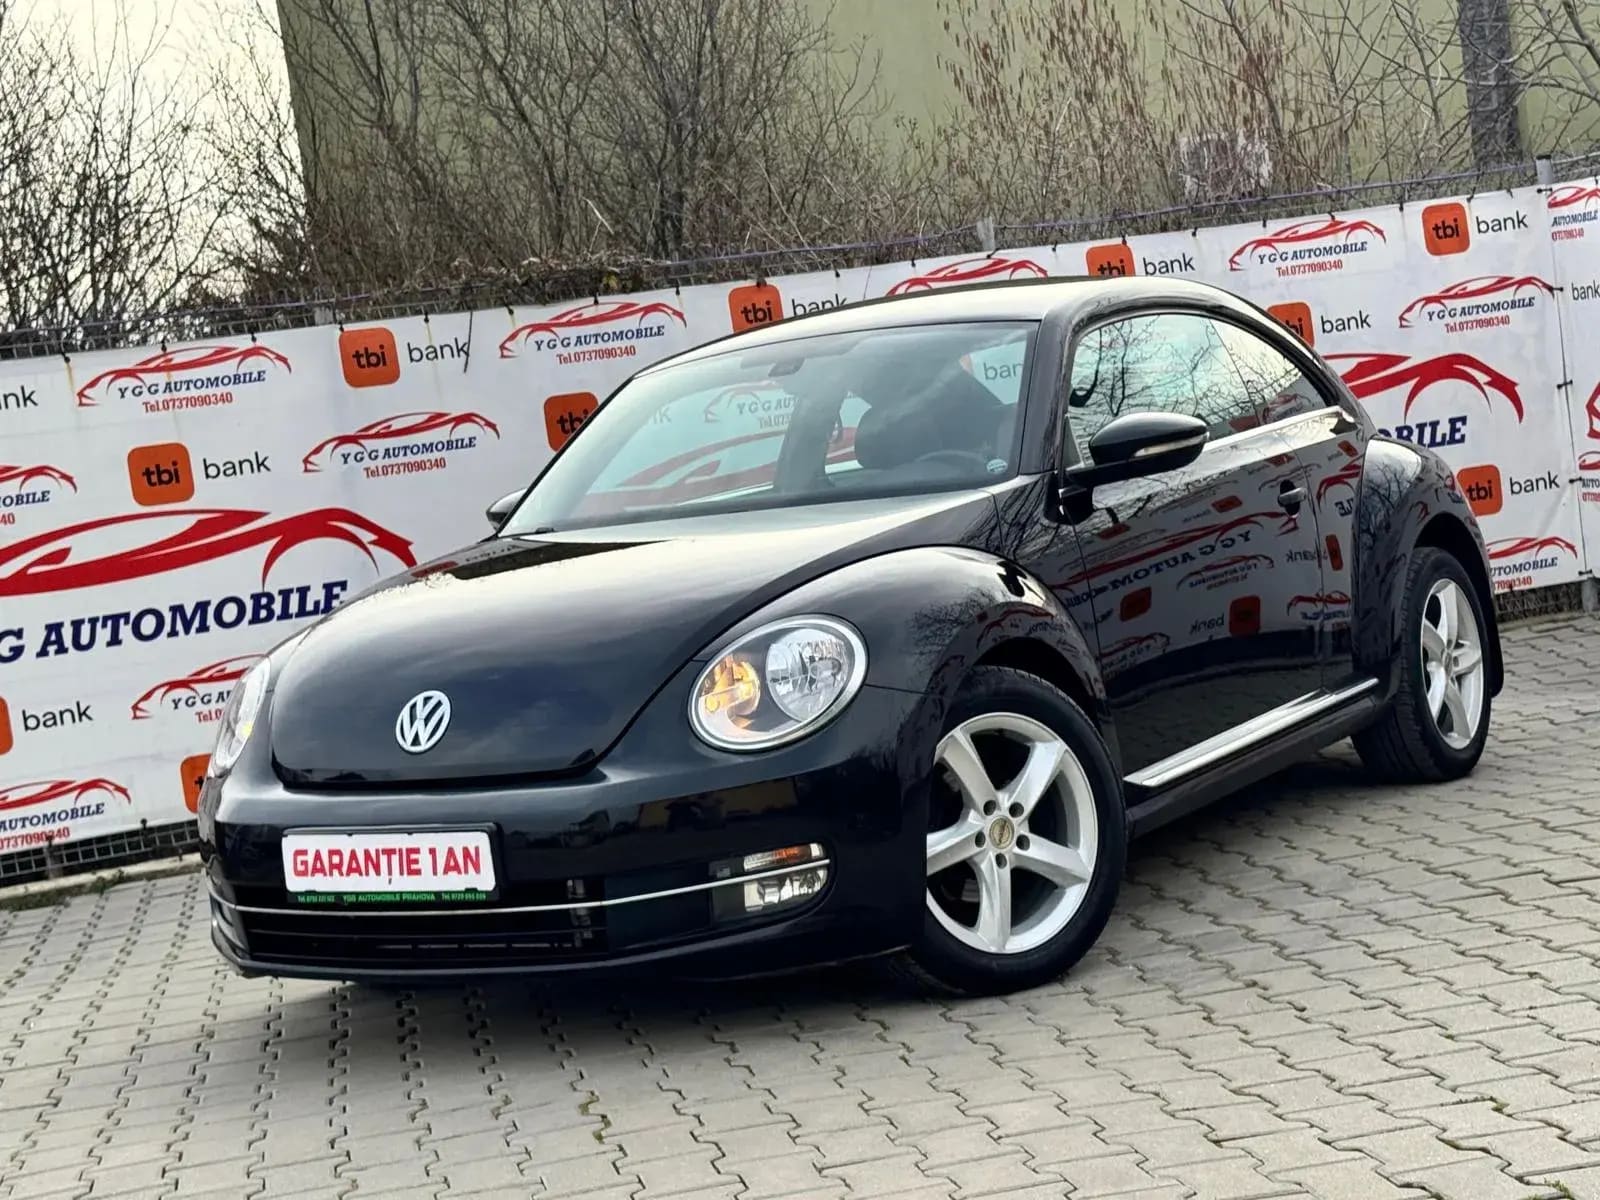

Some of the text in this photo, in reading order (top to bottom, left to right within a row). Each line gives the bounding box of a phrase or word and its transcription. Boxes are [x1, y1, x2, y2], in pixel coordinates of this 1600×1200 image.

[1432, 210, 1528, 240] tbi bank
[1552, 210, 1598, 227] AUTOMOBILE
[1291, 241, 1368, 261] AUTOMOBILE
[1143, 253, 1195, 276] bank
[741, 300, 773, 324] tbi
[1460, 297, 1535, 317] AUTOMOBILE
[1321, 310, 1371, 334] bank
[574, 325, 665, 347] AUTOMOBILE
[352, 337, 470, 369] tbi bank
[163, 370, 266, 393] AUTOMOBILE
[382, 436, 477, 460] AUTOMOBILE
[142, 451, 272, 487] tbi bank
[1466, 471, 1560, 502] tbi bank
[0, 490, 51, 508] OBILE
[36, 580, 349, 658] AUTOMOBILE
[22, 700, 93, 732] bank
[292, 846, 481, 885] GARANȚIE 1 AN
